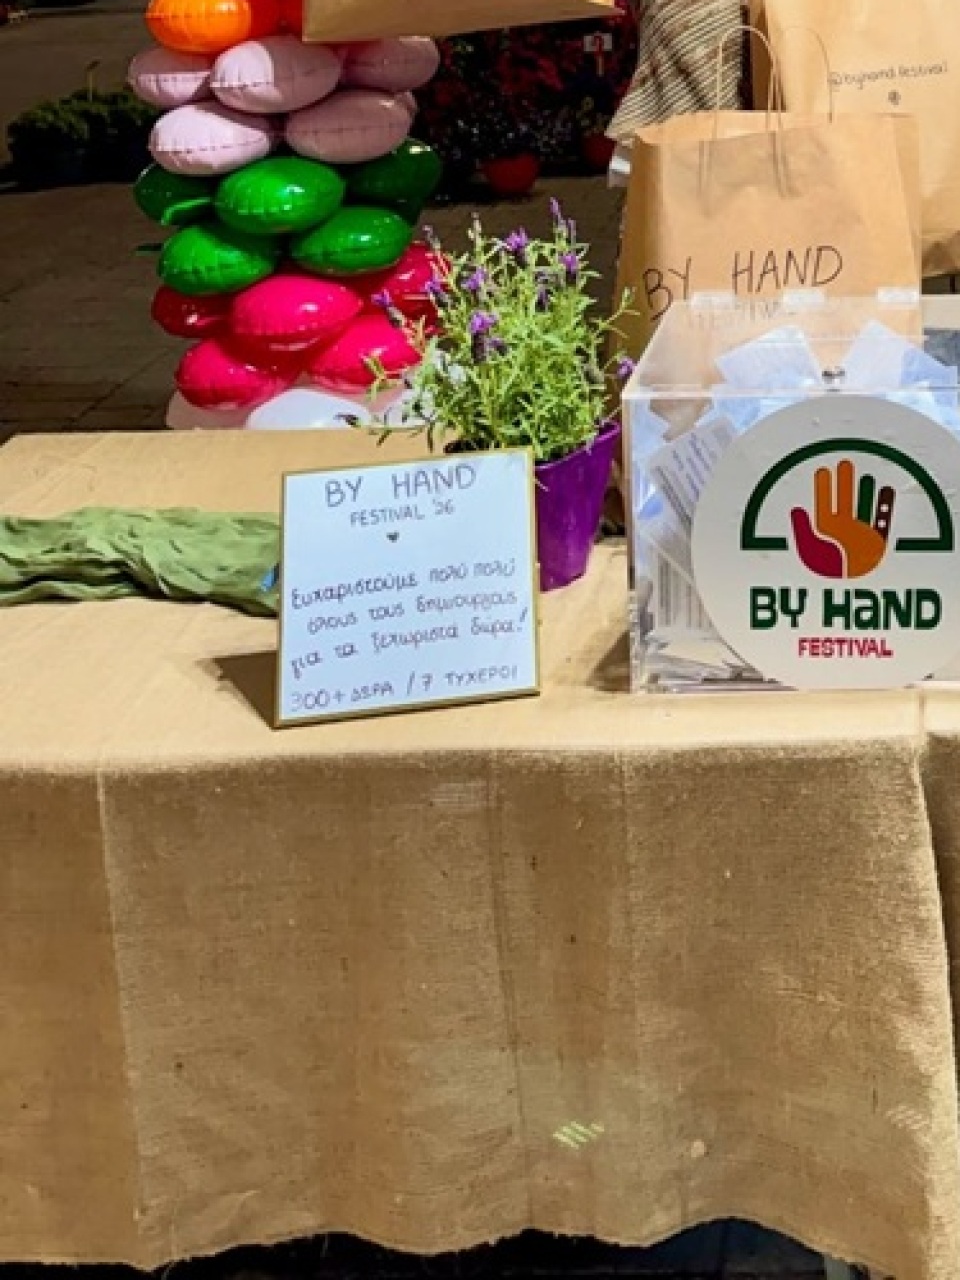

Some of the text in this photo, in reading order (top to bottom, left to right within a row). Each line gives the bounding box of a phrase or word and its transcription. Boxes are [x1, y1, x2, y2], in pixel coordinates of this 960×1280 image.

[643, 256, 692, 322] BY
[732, 245, 843, 295] HAND
[324, 463, 477, 508] BY HAND
[350, 504, 425, 528] FESTIVAL
[368, 602, 404, 621] τους
[750, 586, 808, 630] BY
[290, 650, 323, 679] για
[334, 642, 358, 658] τα
[798, 637, 894, 659] FESTIVAL
